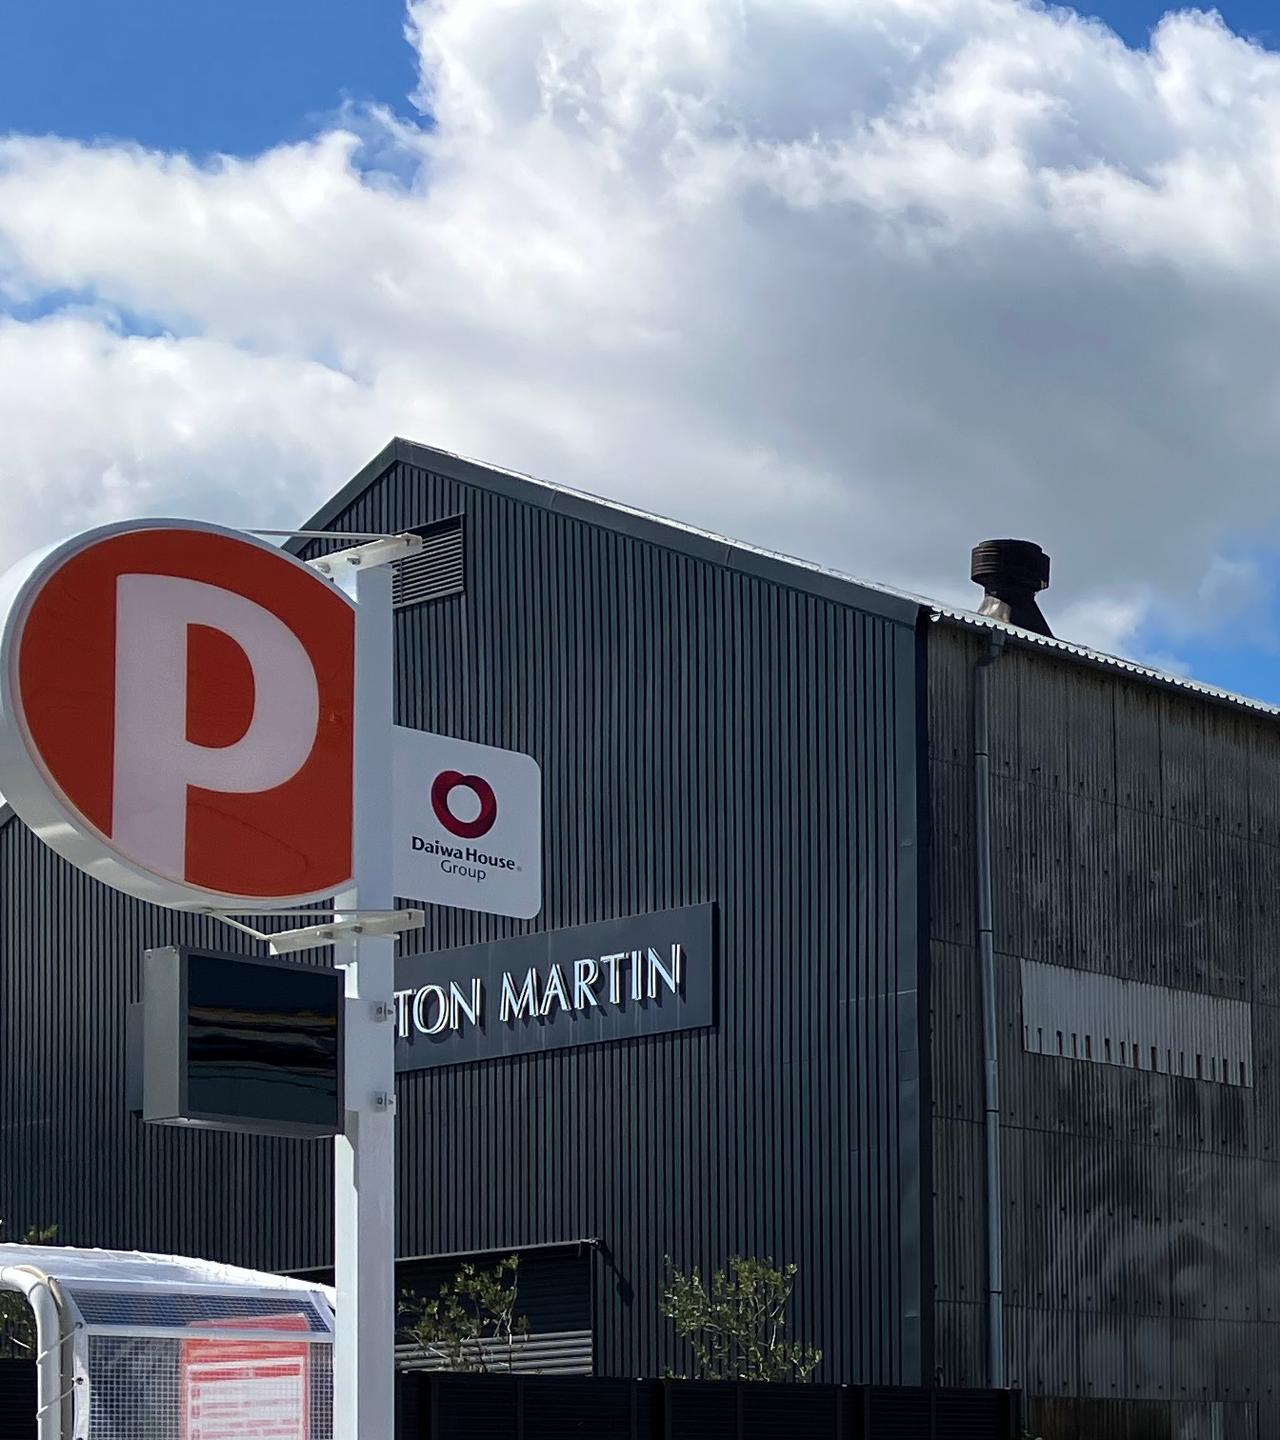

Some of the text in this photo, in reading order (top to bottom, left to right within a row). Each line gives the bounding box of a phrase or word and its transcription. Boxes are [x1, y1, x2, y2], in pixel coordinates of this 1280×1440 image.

[111, 573, 320, 881] P
[412, 836, 516, 871] Daiwa House
[440, 860, 486, 883] Group
[393, 943, 682, 1038] TON MARTIN
